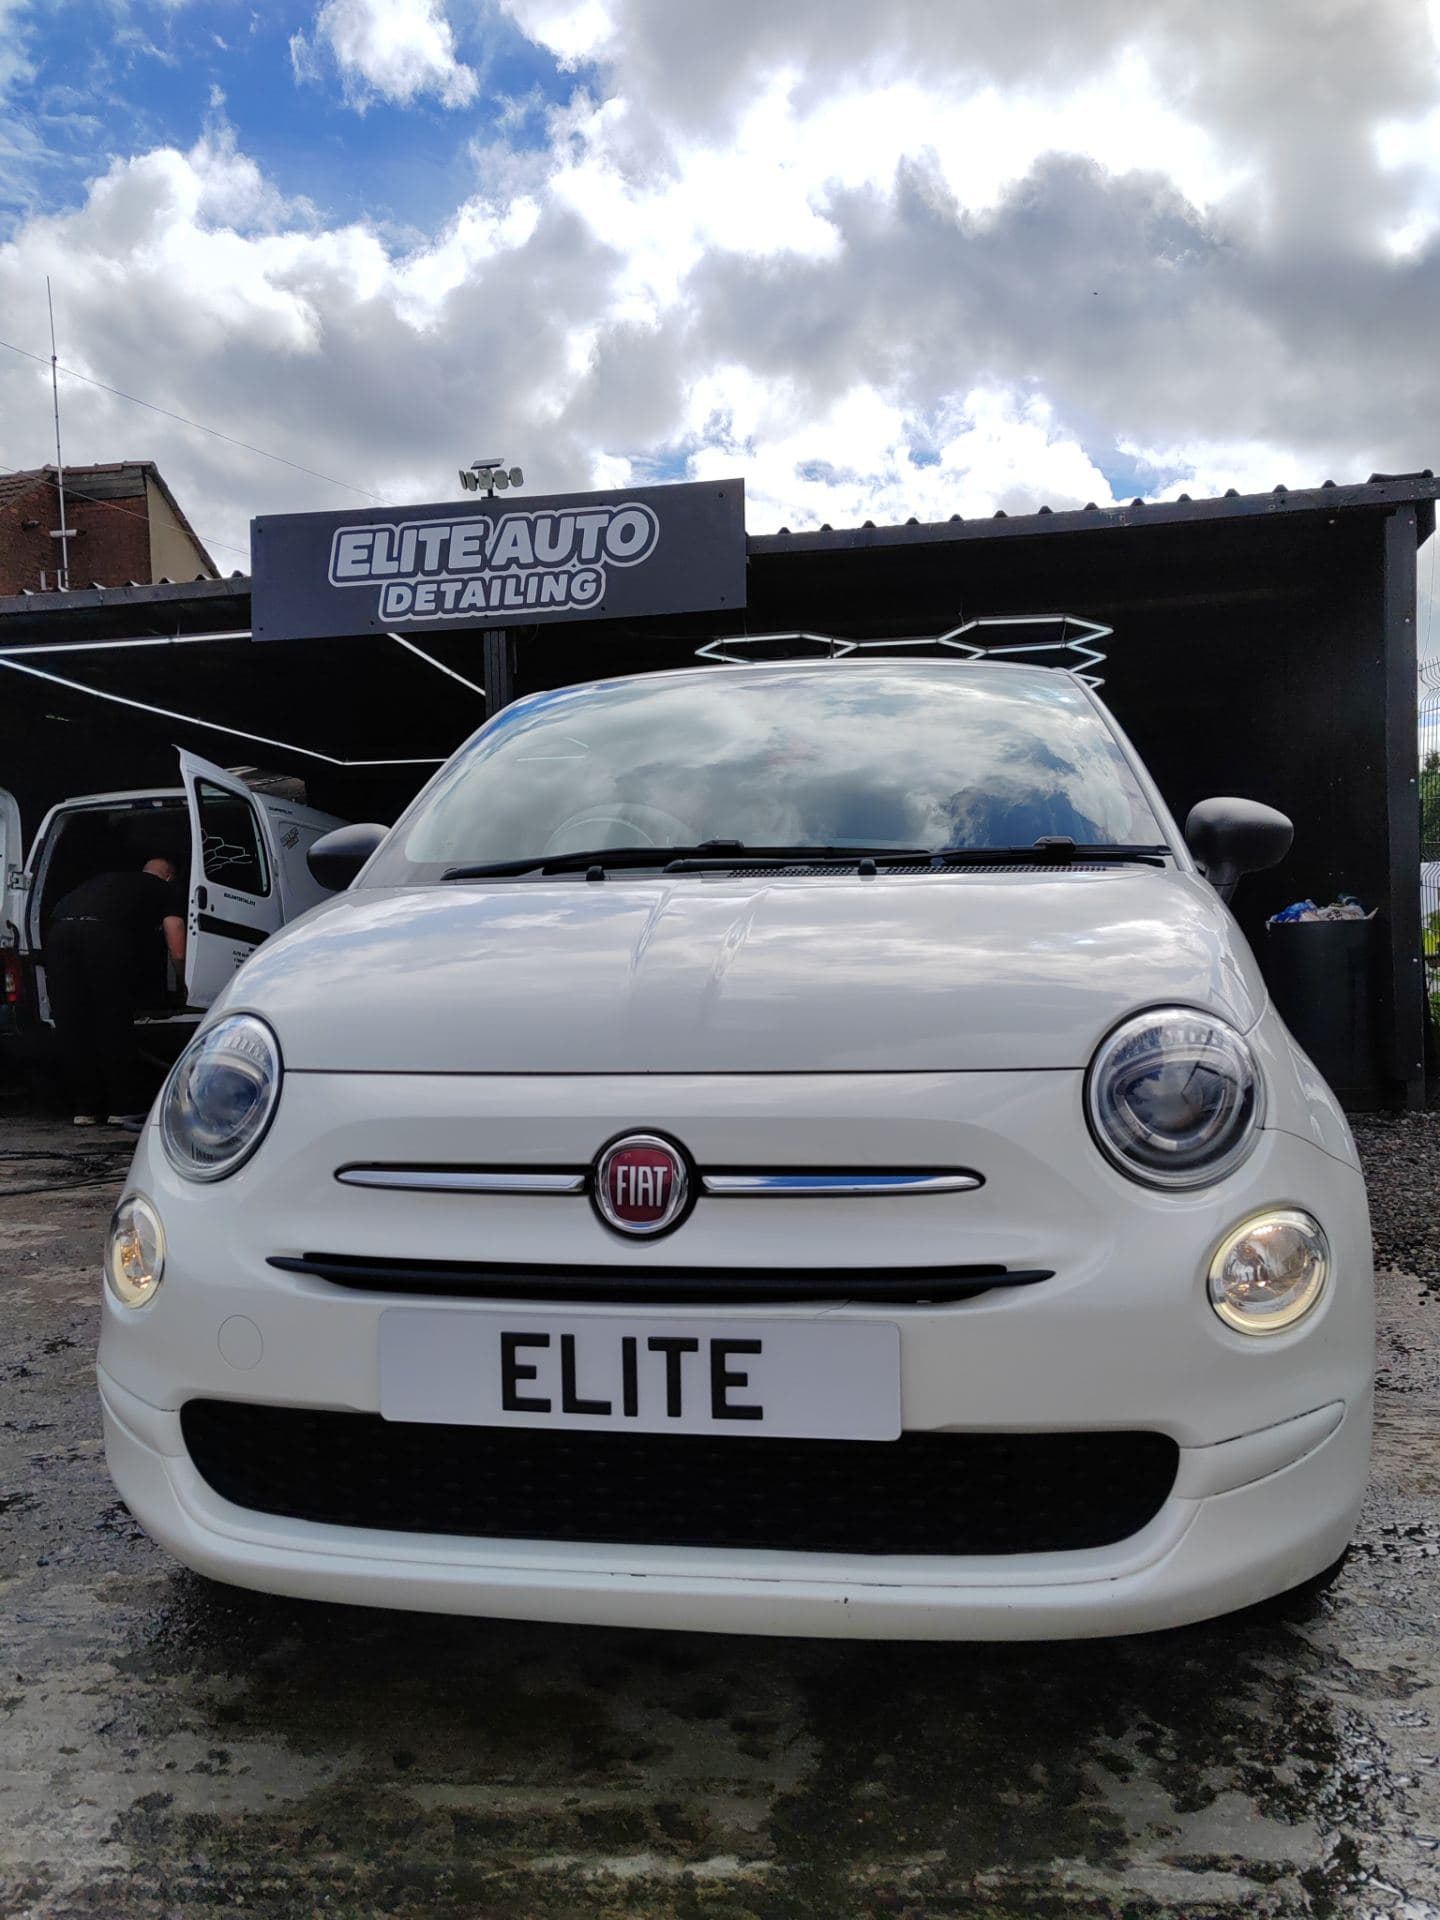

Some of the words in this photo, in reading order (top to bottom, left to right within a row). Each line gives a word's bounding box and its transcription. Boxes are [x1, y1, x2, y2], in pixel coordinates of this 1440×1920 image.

[336, 524, 490, 577] ELITE
[491, 510, 647, 569] AUTO
[385, 575, 597, 613] DETAILING
[616, 1165, 668, 1207] FIAT
[501, 1331, 763, 1421] ELITE
